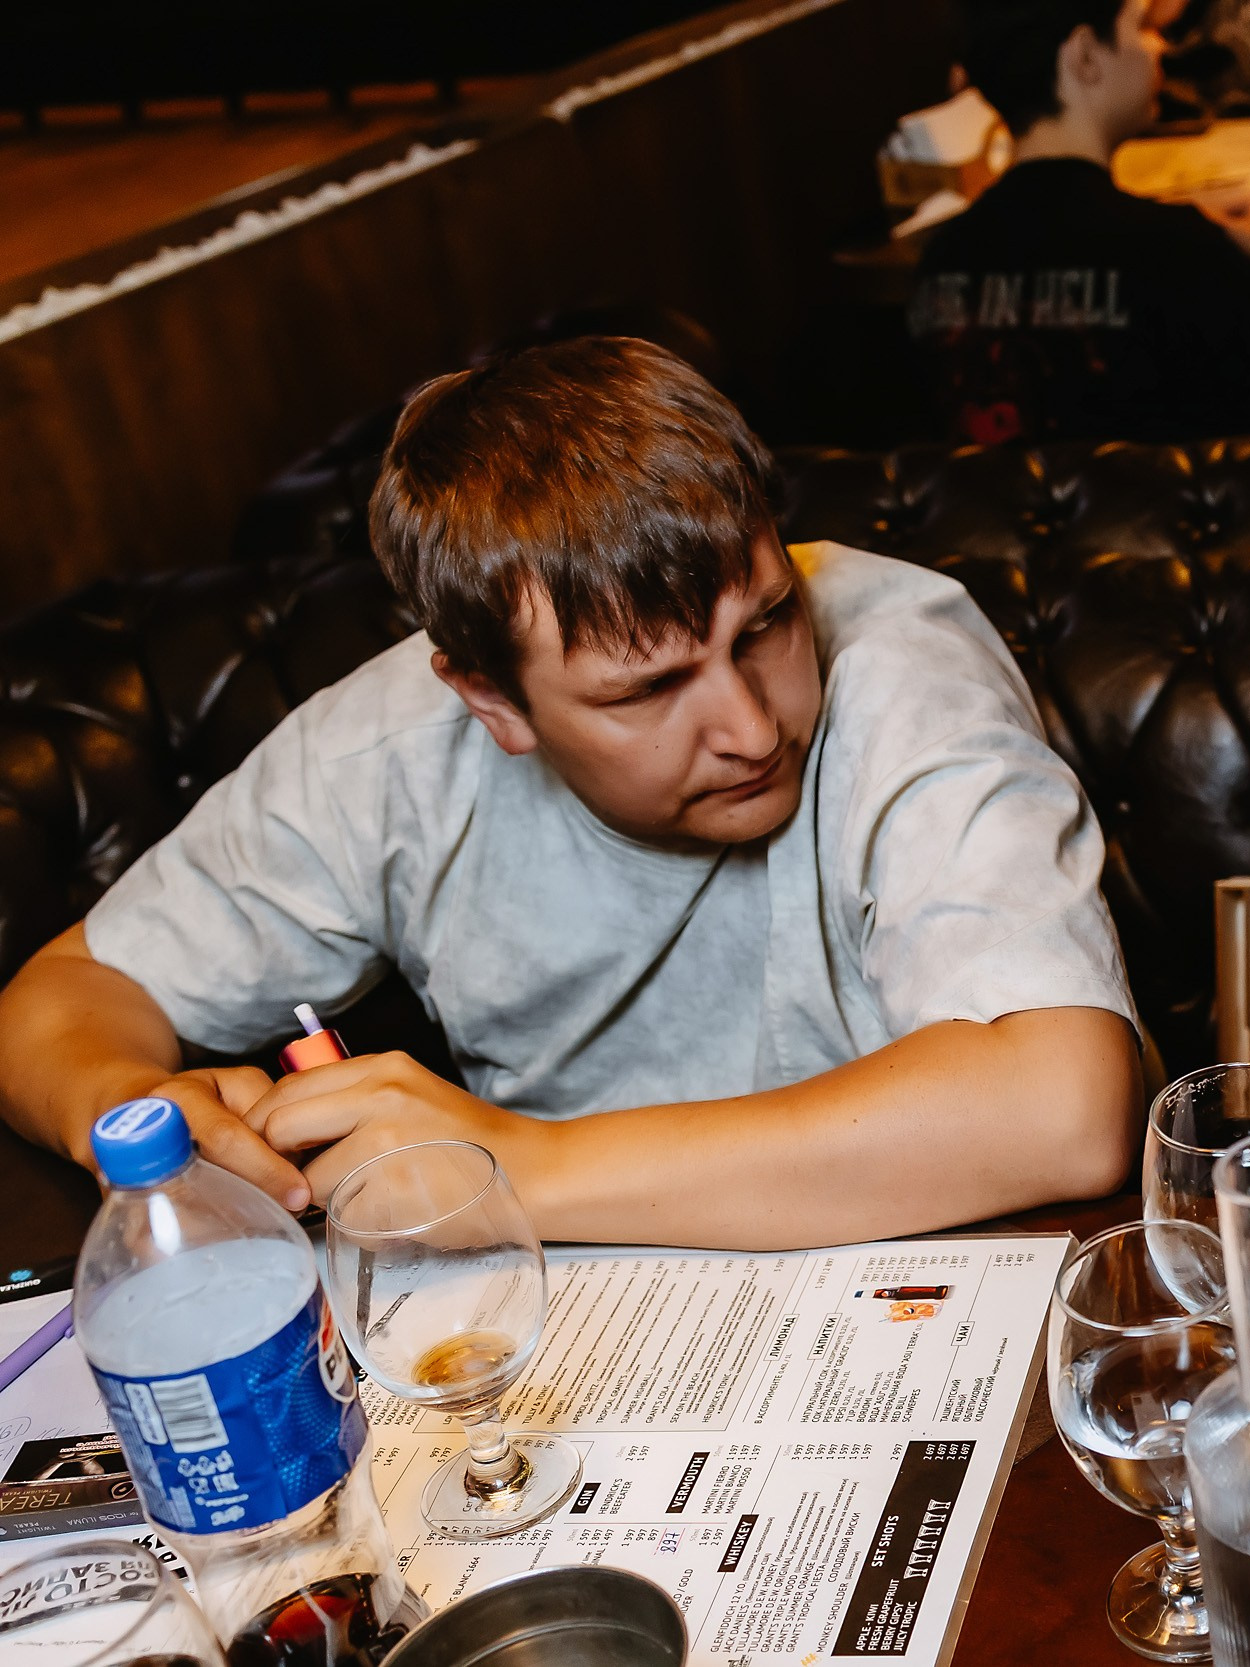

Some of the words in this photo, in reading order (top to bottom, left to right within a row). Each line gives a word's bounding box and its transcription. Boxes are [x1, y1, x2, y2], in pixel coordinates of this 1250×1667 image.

[769, 1317, 796, 1357] ЛИМОНАД
[812, 1317, 837, 1354] НАПИТКИ
[620, 1400, 637, 1423] SUMMER
[633, 1372, 653, 1399] HIGHBALL
[657, 1385, 670, 1399] COLA
[679, 1391, 691, 1402] THE
[685, 1372, 700, 1390] BEACH
[717, 1373, 731, 1389] TONIC
[756, 1374, 782, 1419] АССОРТИМЕНТЕ
[800, 1381, 824, 1422] НАТУРАЛЬНЫЙ
[817, 1368, 829, 1380] СОК
[816, 1368, 840, 1409] НАТУРАЛЬНЫЙ
[828, 1390, 842, 1405] ZERO
[879, 1380, 901, 1422] МИНЕРАЛЬНАЯ
[895, 1363, 908, 1379] ВОДА
[974, 1375, 995, 1421] КЛАССИЧЕСКИЙ
[521, 1407, 537, 1424] TULLY
[535, 1384, 551, 1401] TONIC
[546, 1399, 565, 1424] DAIQUIRI
[571, 1403, 588, 1424] APEROL
[582, 1383, 599, 1402] SPRITZ
[595, 1397, 615, 1423] TROPICAL
[675, 1402, 685, 1411] ON
[811, 1410, 823, 1422] СОК
[822, 1406, 835, 1422] PEPSI
[833, 1406, 846, 1422] PEPSI
[856, 1397, 872, 1422] BORJOMI
[867, 1406, 880, 1422] ВОДА
[890, 1410, 901, 1422] RED
[894, 1394, 907, 1409] BULL
[901, 1388, 921, 1422] SCHWEPPES
[939, 1379, 961, 1422] ТАШКЕНТСКИЙ
[951, 1394, 966, 1422] ЯГОДНЫЙ
[962, 1377, 984, 1422] ОБЛЕПИХОВЫЙ
[669, 1412, 681, 1423] SEX
[577, 1489, 594, 1506] GIN
[609, 1481, 632, 1514] BEEFEATER
[671, 1456, 704, 1507] VERMOUTH
[701, 1488, 719, 1513] MARTINI
[713, 1465, 729, 1487] FIERRO
[712, 1488, 731, 1514] MARTINI
[724, 1464, 741, 1487] BIANCO
[724, 1488, 742, 1513] MARTINI
[736, 1467, 752, 1487] ROSSO
[1, 1491, 72, 1512] TEREA
[99, 1512, 127, 1521] IQOS
[17, 1525, 56, 1535] TWILIGHT
[66, 1515, 97, 1527] ILUMA
[878, 1515, 899, 1546] SHOTS
[723, 1520, 752, 1565] WHISKEY
[827, 1537, 851, 1582] СОЛОДОВЫЙ
[844, 1512, 860, 1535] ВИСКИ
[870, 1548, 887, 1566] SET
[452, 1573, 471, 1595] BLANC
[465, 1556, 480, 1572] 1664
[678, 1568, 693, 1587] GOLD
[784, 1591, 803, 1621] SUMMER
[797, 1561, 815, 1589] ORANGE
[796, 1587, 817, 1621] TROPICAL
[810, 1564, 826, 1586] FIESTA
[734, 1610, 760, 1652] TULLAMORE
[761, 1563, 778, 1586] HONEY
[747, 1609, 772, 1653] TULLAMORE
[773, 1555, 794, 1587] ORIGINAL
[771, 1597, 789, 1621] TRIPLE
[782, 1574, 798, 1596] WOOD
[867, 1625, 884, 1650] FRESH
[876, 1578, 899, 1624] GRAPEFRUIT
[899, 1601, 917, 1628] TROPIC
[709, 1605, 736, 1652] GLENFIDDICH
[730, 1595, 741, 1603] 12
[815, 1621, 833, 1652] MONKEY
[827, 1582, 848, 1620] SHOULDER
[855, 1626, 871, 1650] APPLE
[864, 1603, 879, 1621] KIWI
[880, 1625, 896, 1650] BERRY
[889, 1602, 903, 1624] GIPSY
[722, 1636, 736, 1653] JACK
[893, 1629, 907, 1651] JUICY
